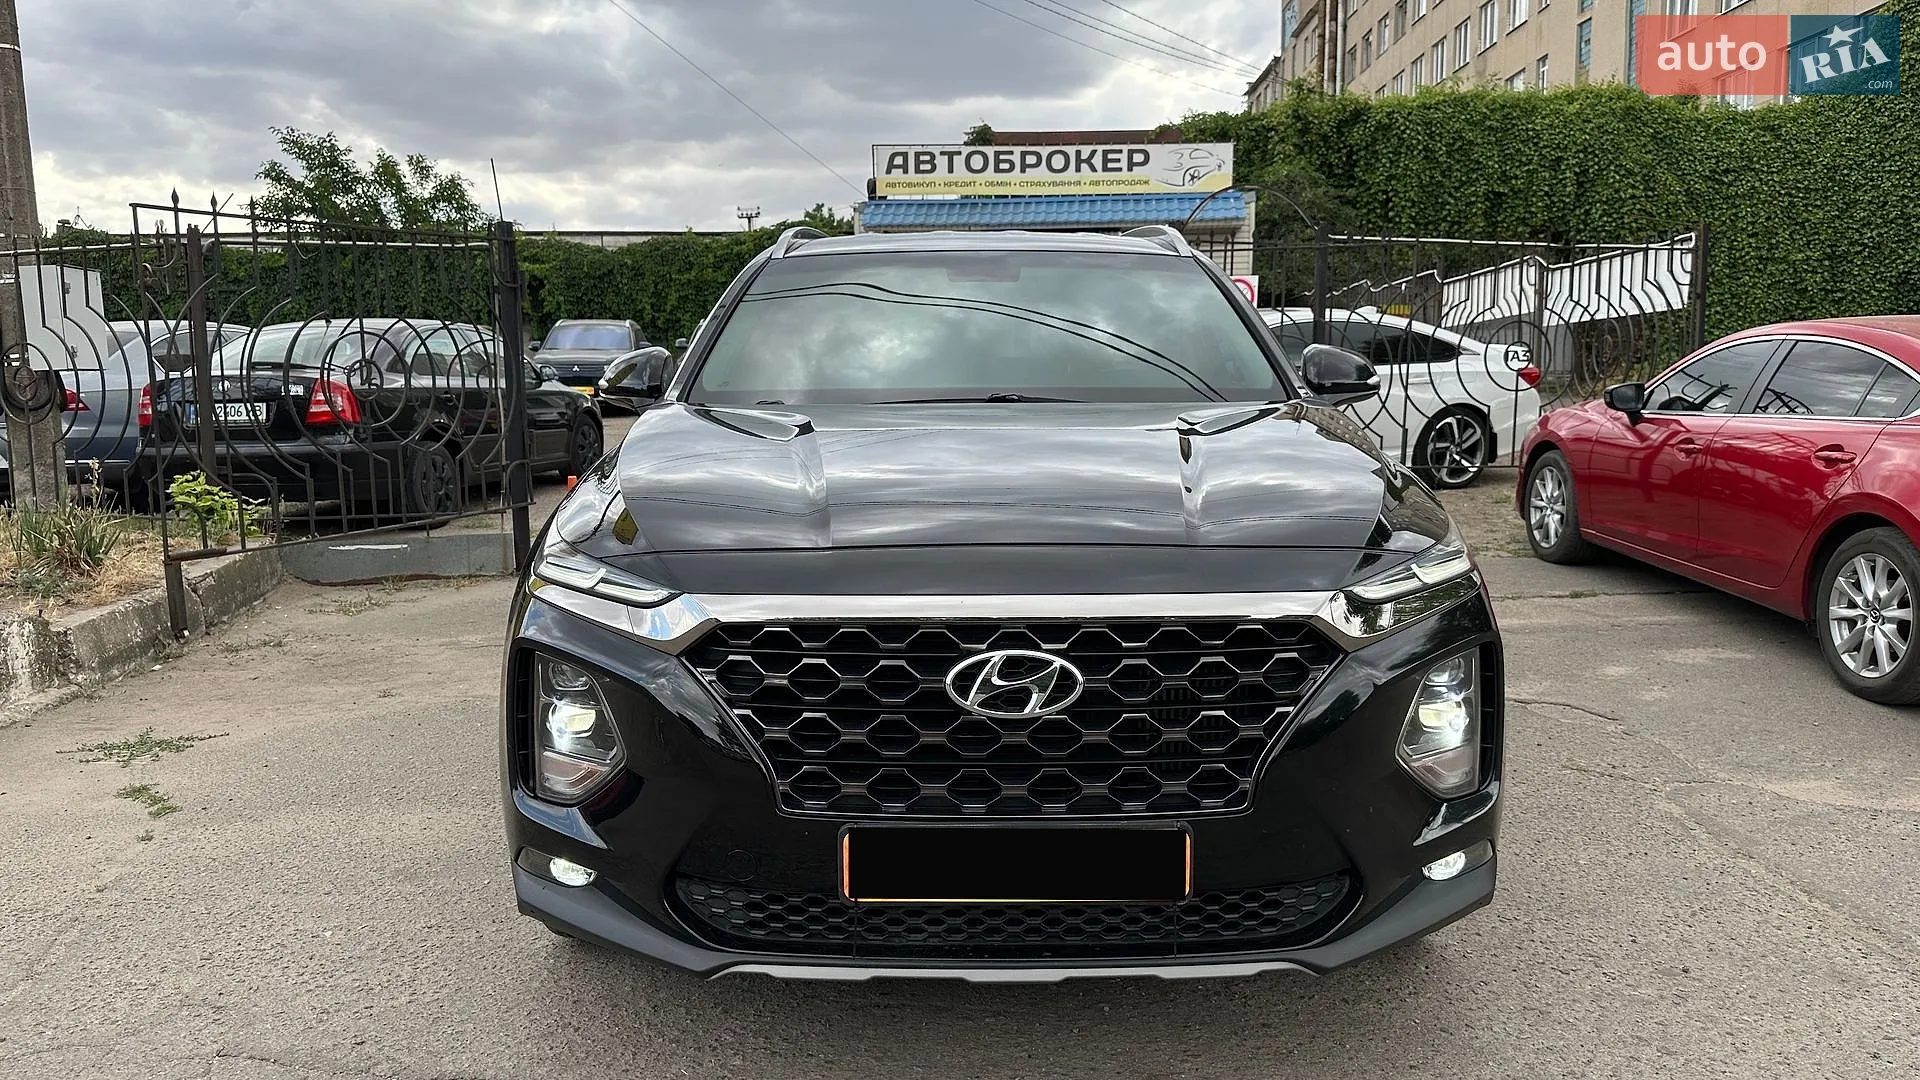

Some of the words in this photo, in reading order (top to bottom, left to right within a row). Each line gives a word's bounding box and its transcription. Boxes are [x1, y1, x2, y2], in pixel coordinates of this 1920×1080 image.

[885, 149, 1150, 175] АВТОБРОКЕР
[885, 181, 936, 189] АВТОВИКУП
[943, 180, 977, 188] КРЕДИТ
[984, 180, 1011, 188] ОБМІН
[1018, 180, 1081, 188] СТРАХУВАННЯ
[1088, 179, 1150, 187] АВТОПРОДАЖ
